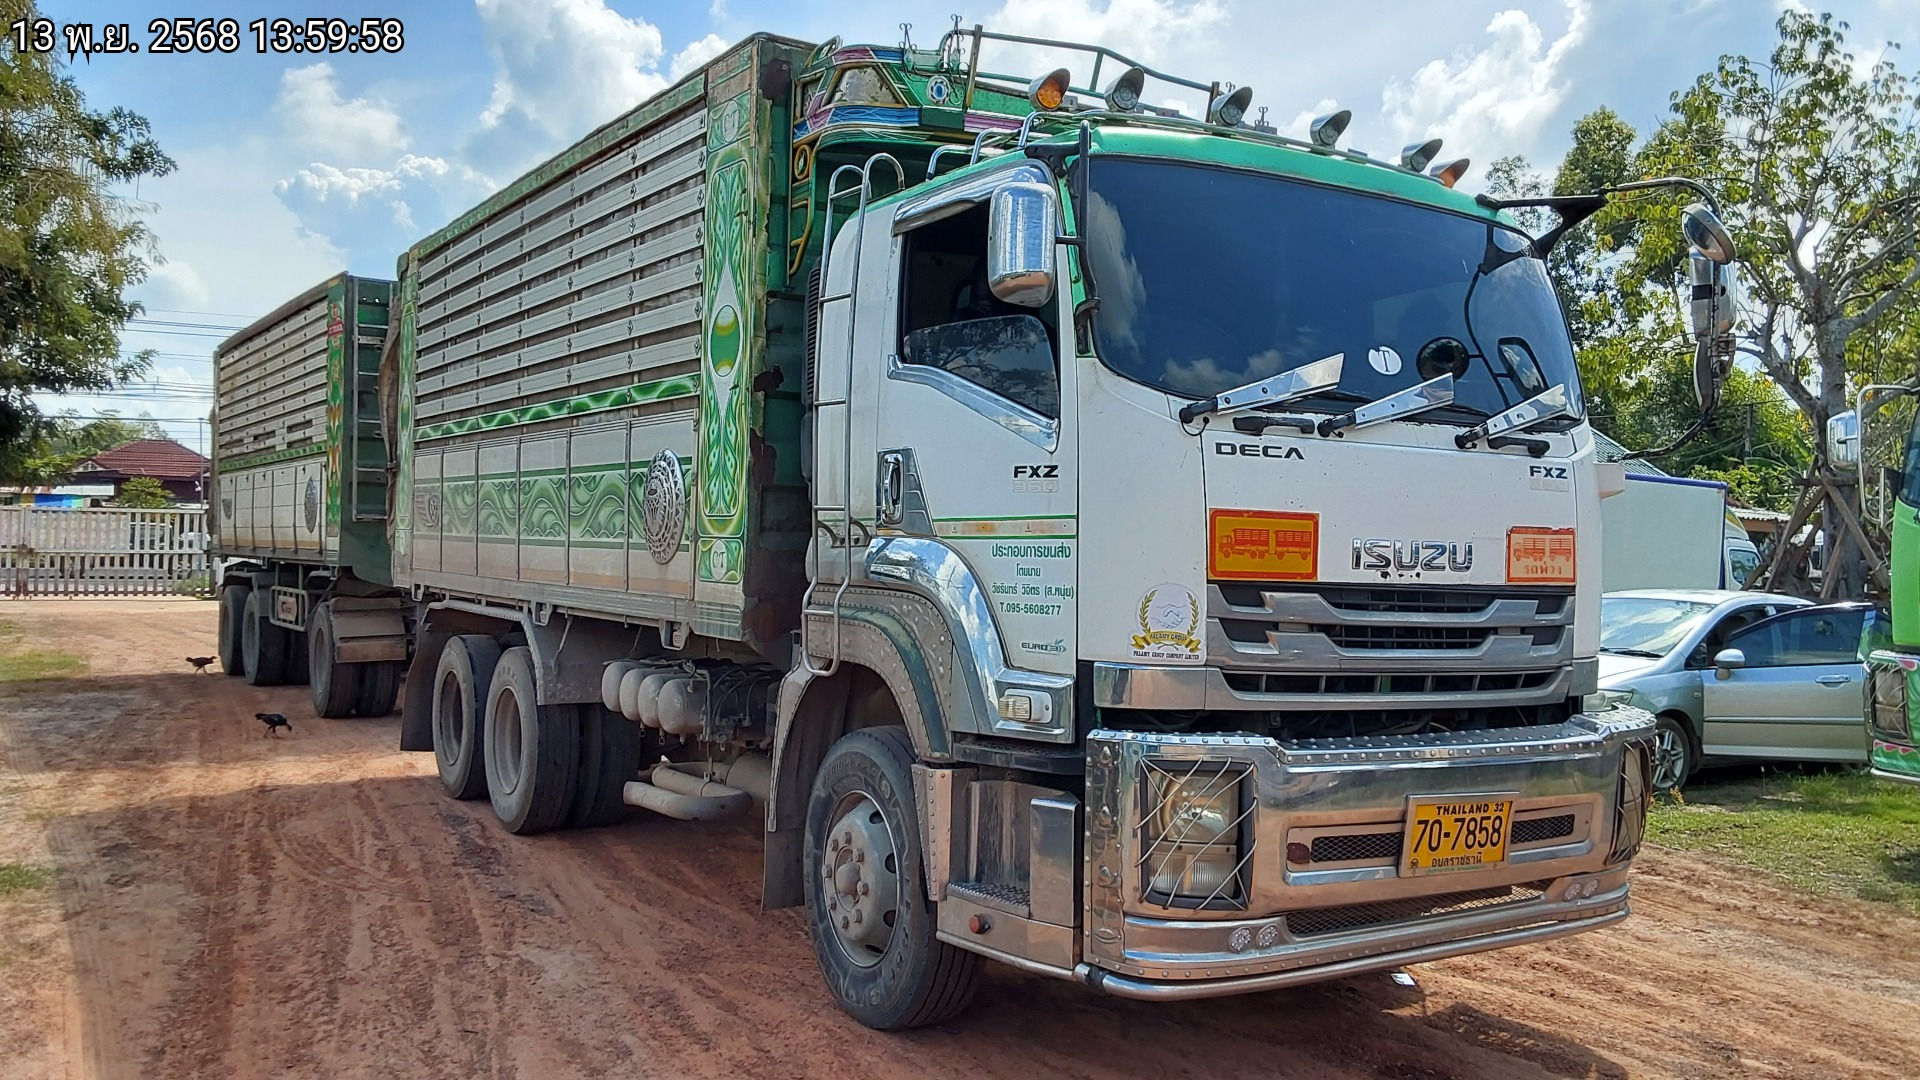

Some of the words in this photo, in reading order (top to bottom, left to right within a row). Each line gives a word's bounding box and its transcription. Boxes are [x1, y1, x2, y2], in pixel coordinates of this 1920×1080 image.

[1215, 442, 1305, 460] DECA
[1013, 464, 1059, 478] FXZ
[1529, 465, 1568, 480] FXZ
[991, 541, 1072, 558] ประกอบการขนส่ง
[1351, 538, 1473, 572] ISUZU
[1016, 562, 1041, 577] โดยนาย
[1523, 560, 1562, 575] รถพ่วง
[999, 602, 1062, 616] T.095-5608277
[1021, 642, 1048, 651] EURO
[1436, 803, 1490, 816] THAILAND
[1493, 802, 1505, 813] 32
[1412, 815, 1503, 853] 70-7858
[1431, 852, 1483, 868] อบลราชธานี
